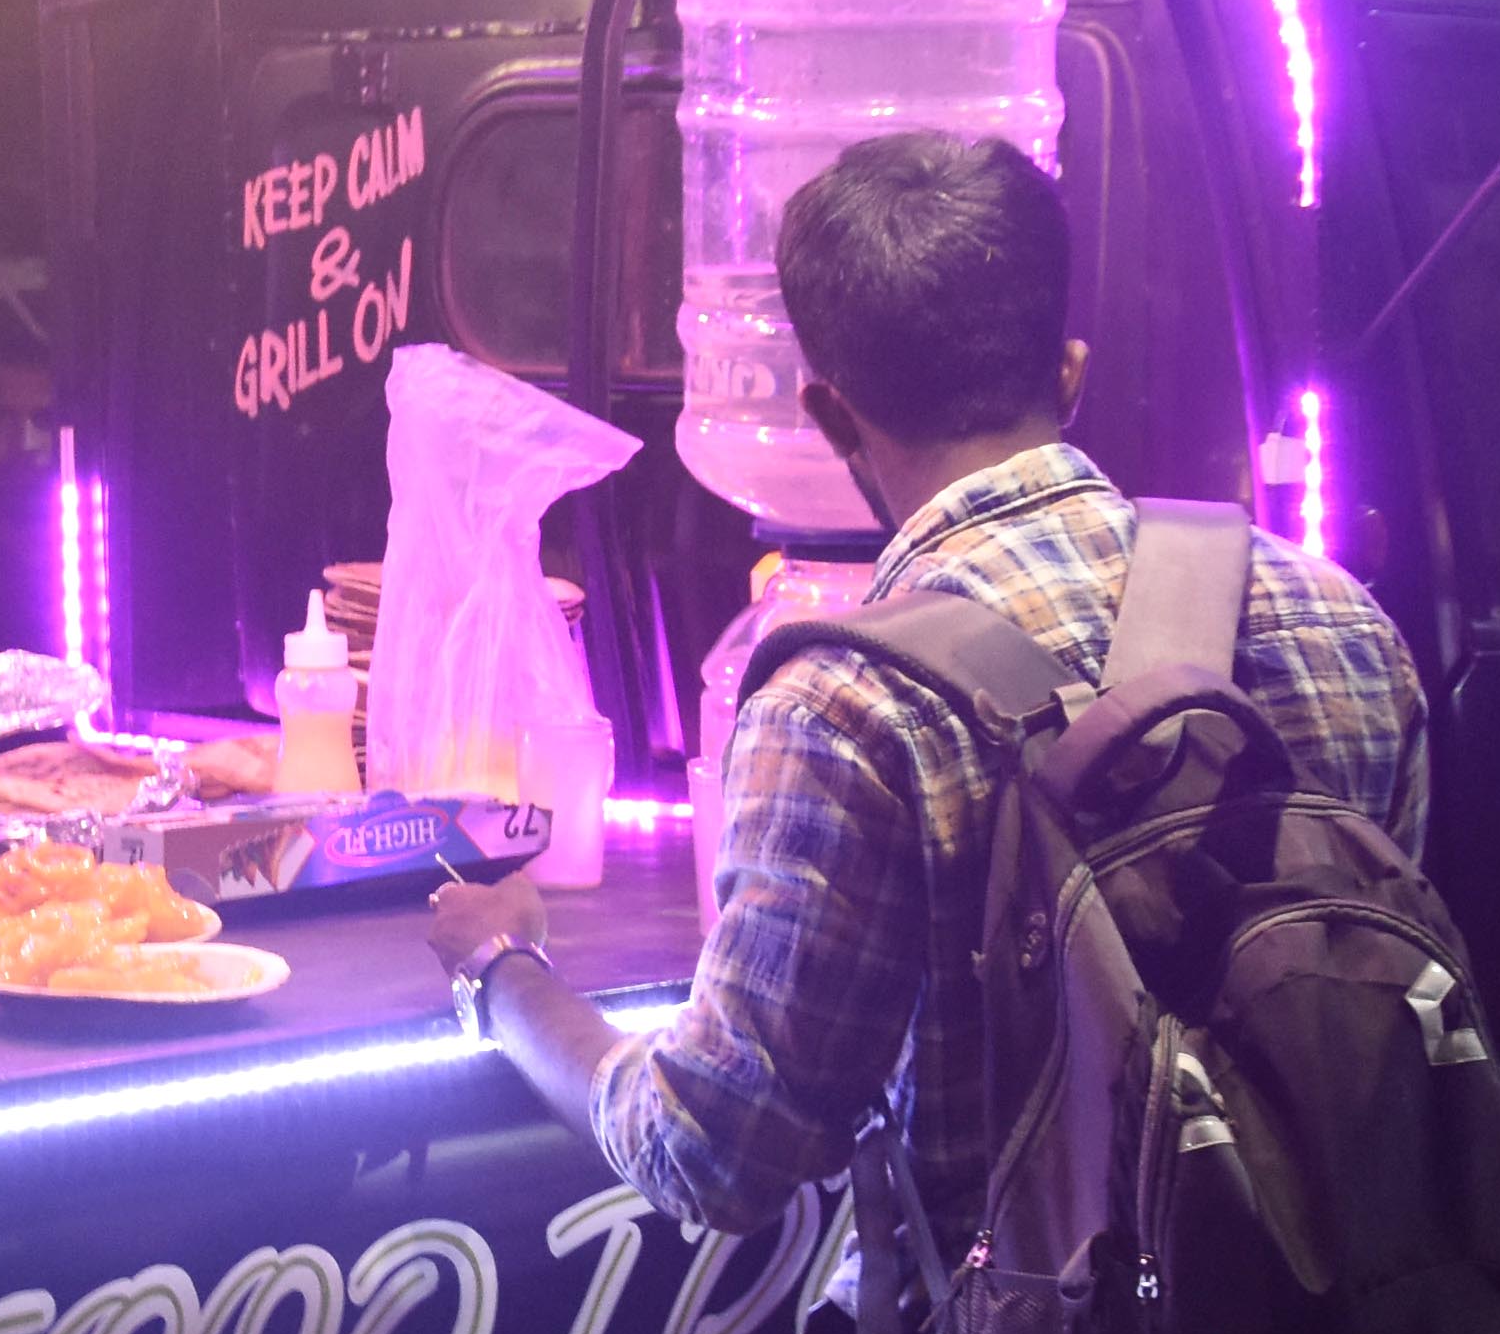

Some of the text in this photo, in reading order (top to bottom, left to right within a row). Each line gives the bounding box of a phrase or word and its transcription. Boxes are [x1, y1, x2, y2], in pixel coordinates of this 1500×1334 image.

[243, 106, 425, 250] KEEP CALM
[235, 235, 413, 418] GRILL ON
[310, 226, 361, 302] &
